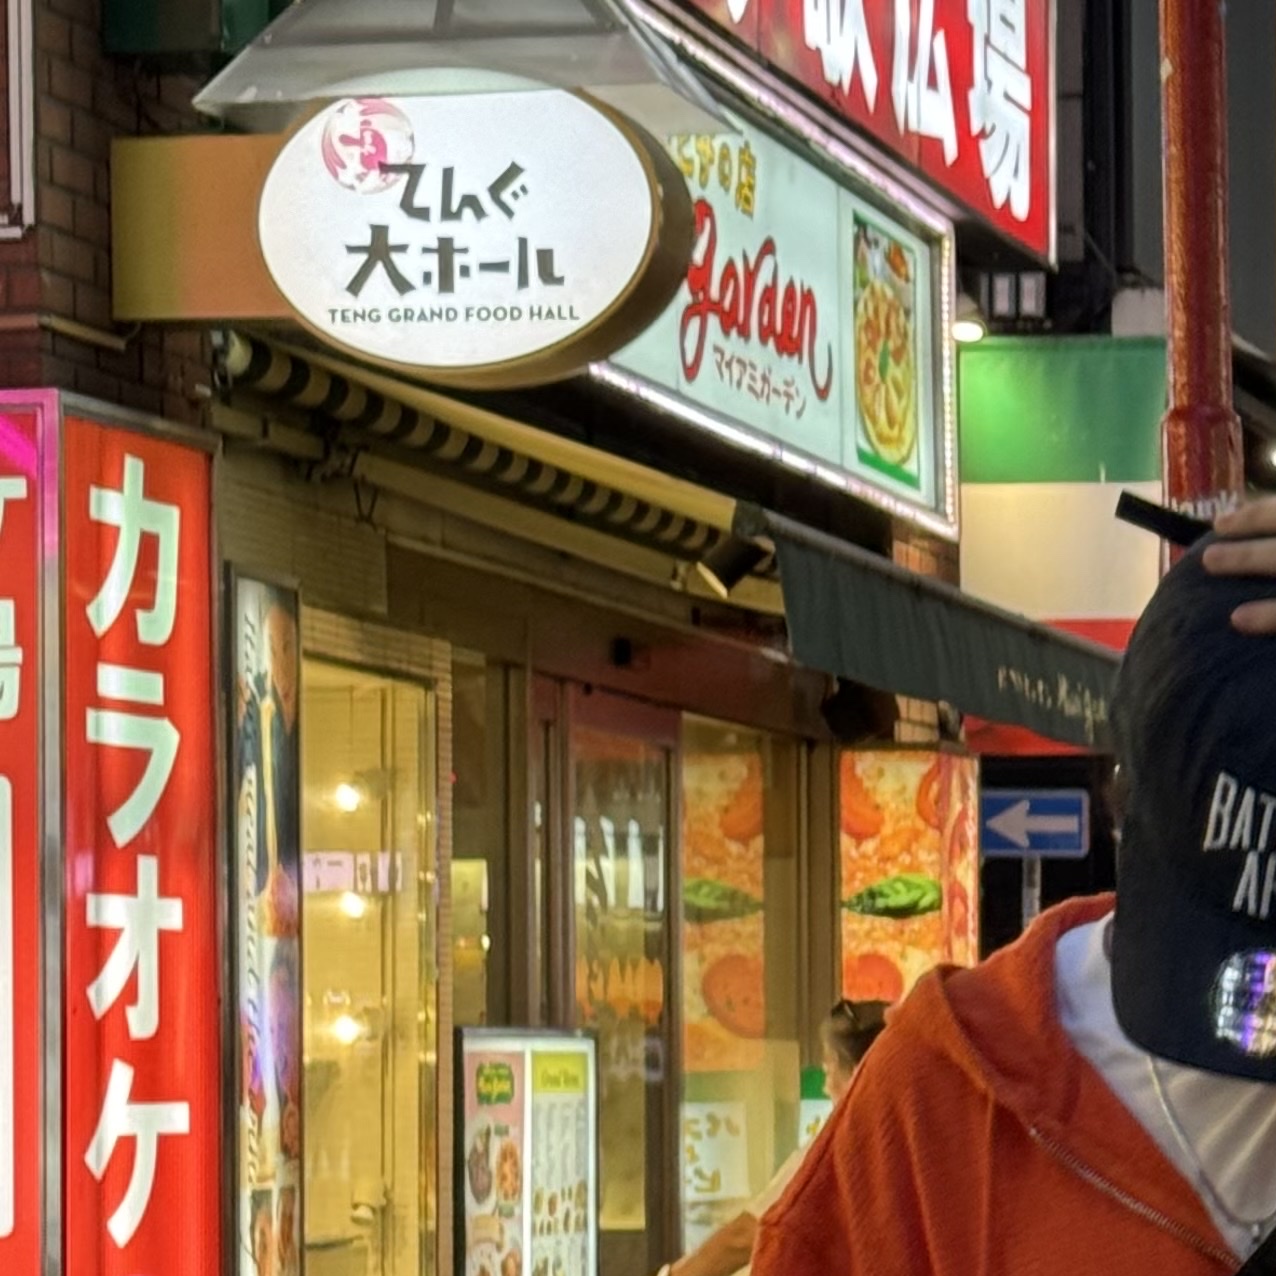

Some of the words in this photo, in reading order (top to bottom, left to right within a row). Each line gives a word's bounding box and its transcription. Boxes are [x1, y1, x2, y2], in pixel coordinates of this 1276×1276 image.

[378, 161, 529, 222] てんぐ
[345, 223, 565, 298] 大ホール
[328, 307, 382, 324] TENG
[387, 306, 458, 324] GRAND
[465, 305, 523, 322] FOOD
[528, 304, 580, 321] HALL
[713, 343, 807, 420] マイアミガーデン
[85, 453, 191, 1249] カラオケ
